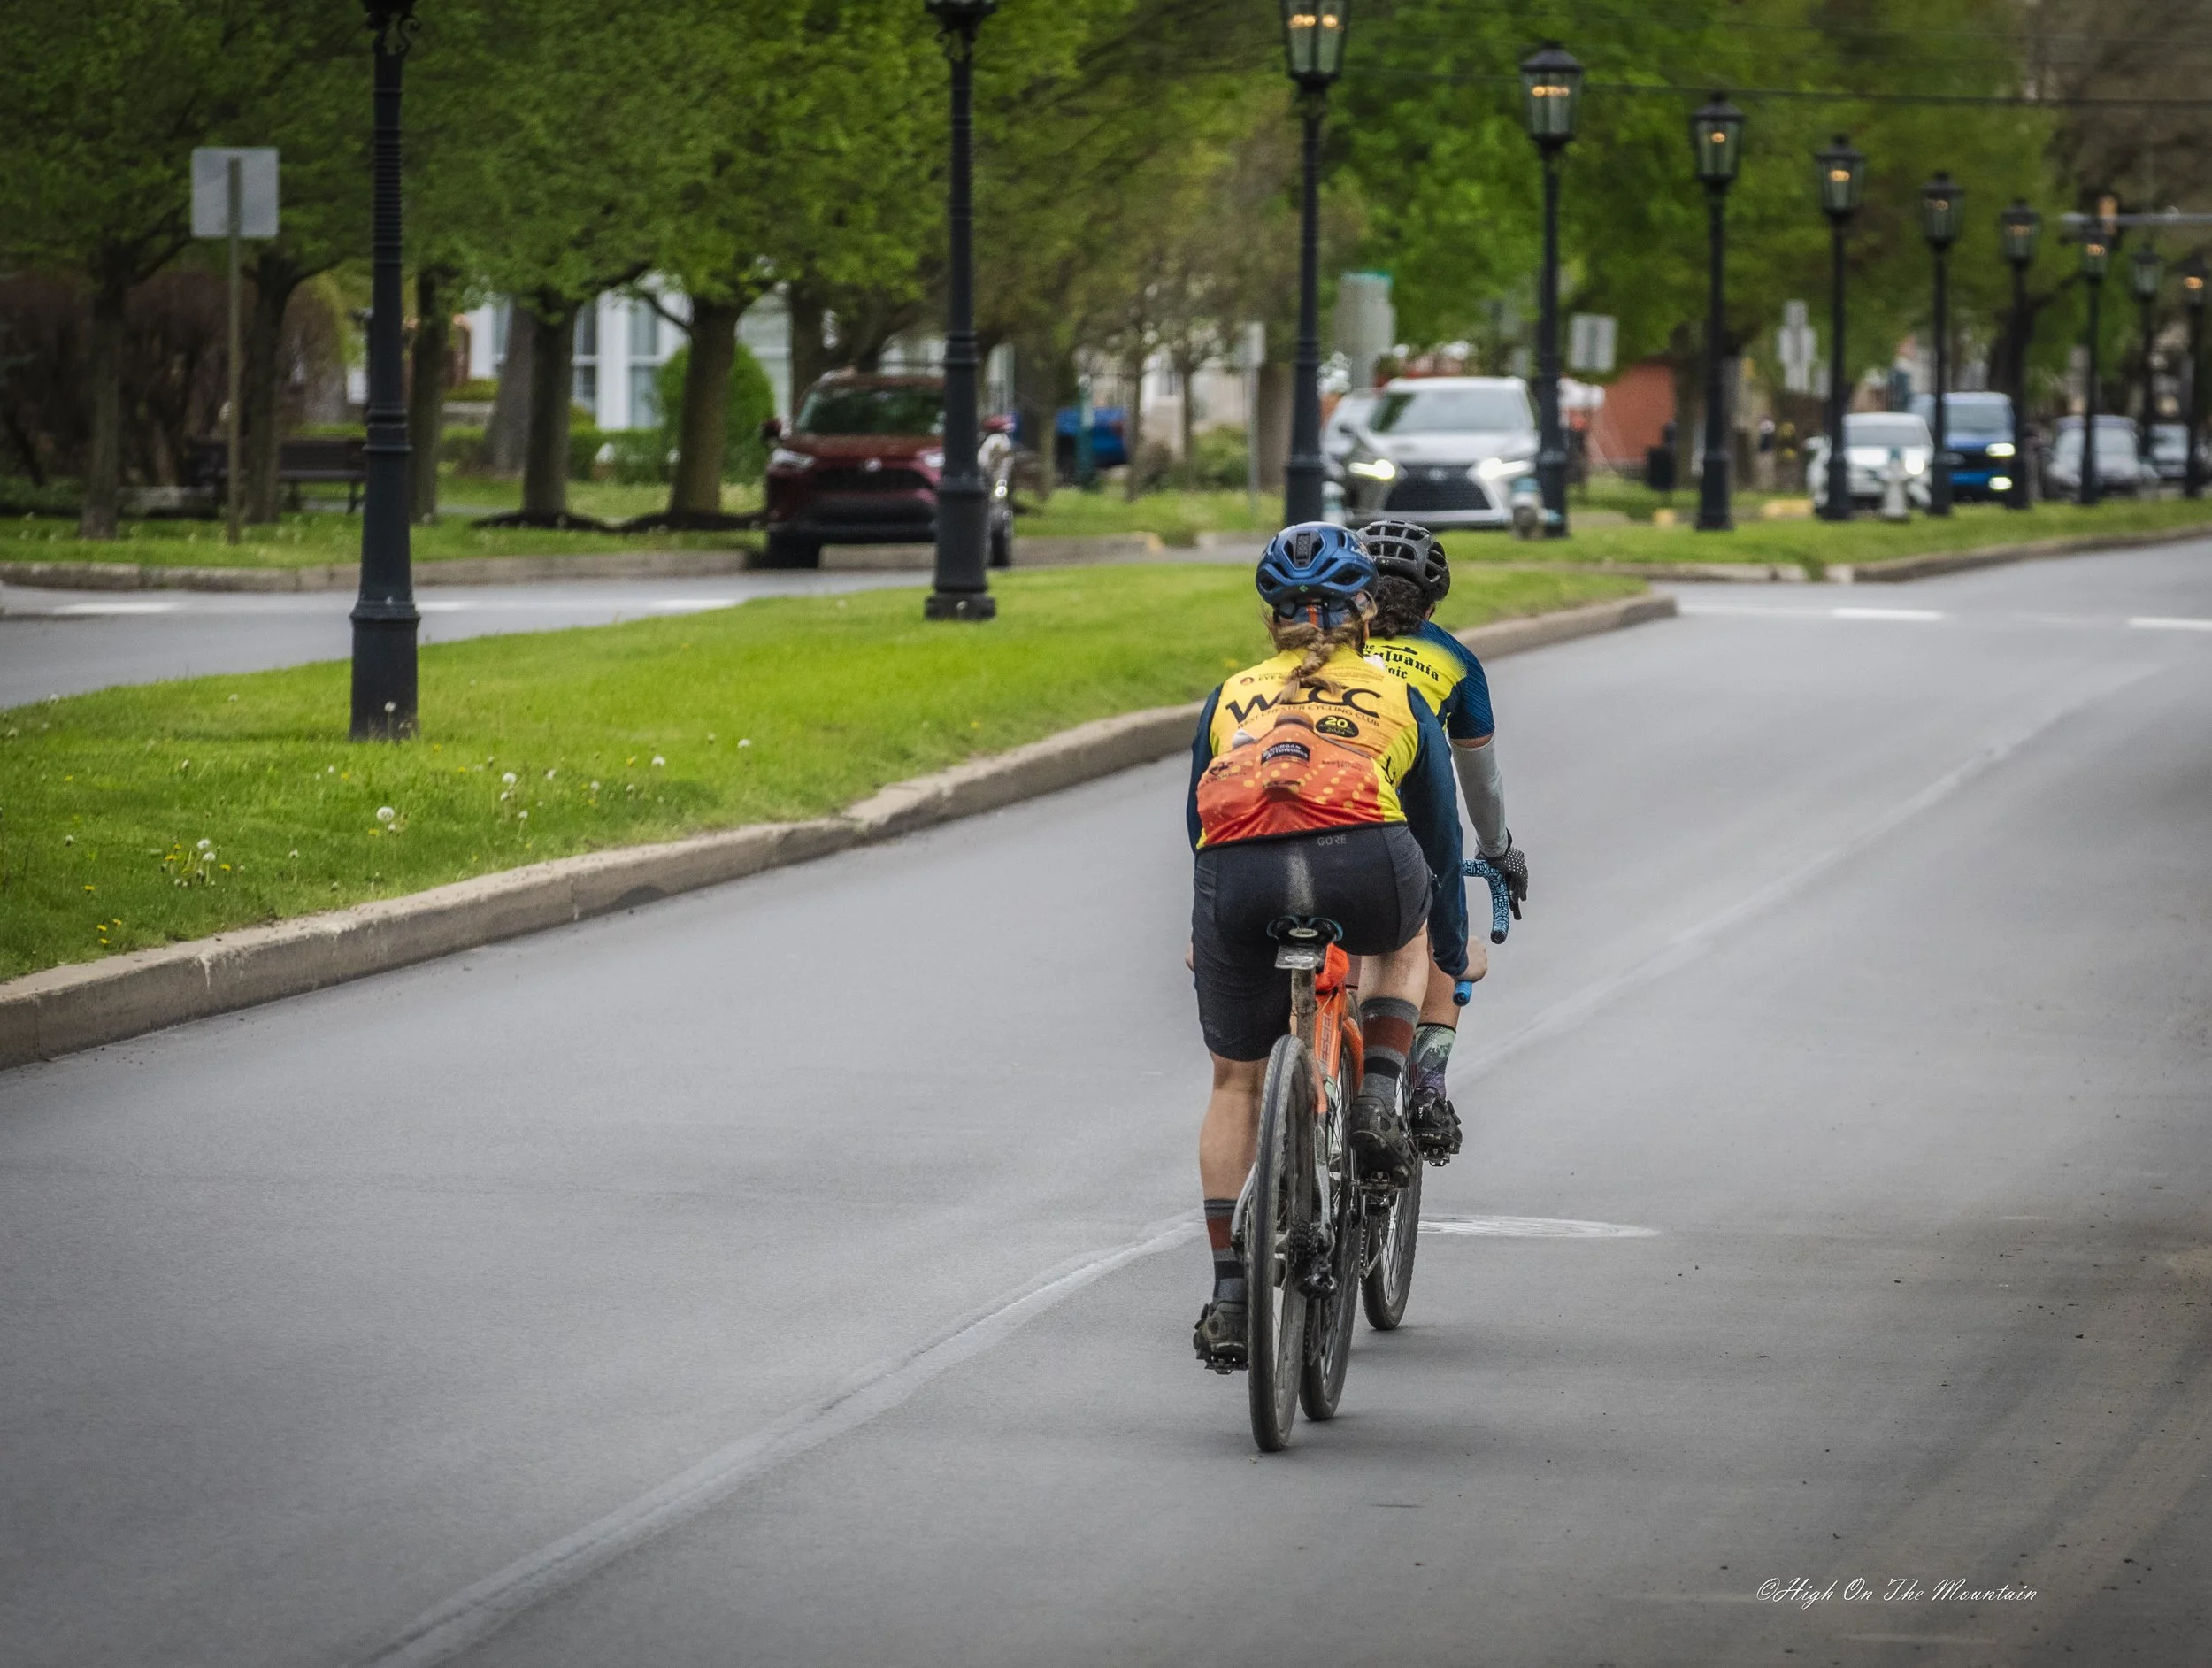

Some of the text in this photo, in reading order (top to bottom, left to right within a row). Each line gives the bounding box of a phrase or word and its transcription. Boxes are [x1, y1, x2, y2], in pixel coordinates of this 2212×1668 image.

[1262, 705, 1305, 717] CHESTER
[1308, 704, 1353, 715] CYCLING
[1355, 712, 1379, 726] CLUB
[1325, 716, 1348, 728] 20
[1317, 834, 1348, 846] GORE
